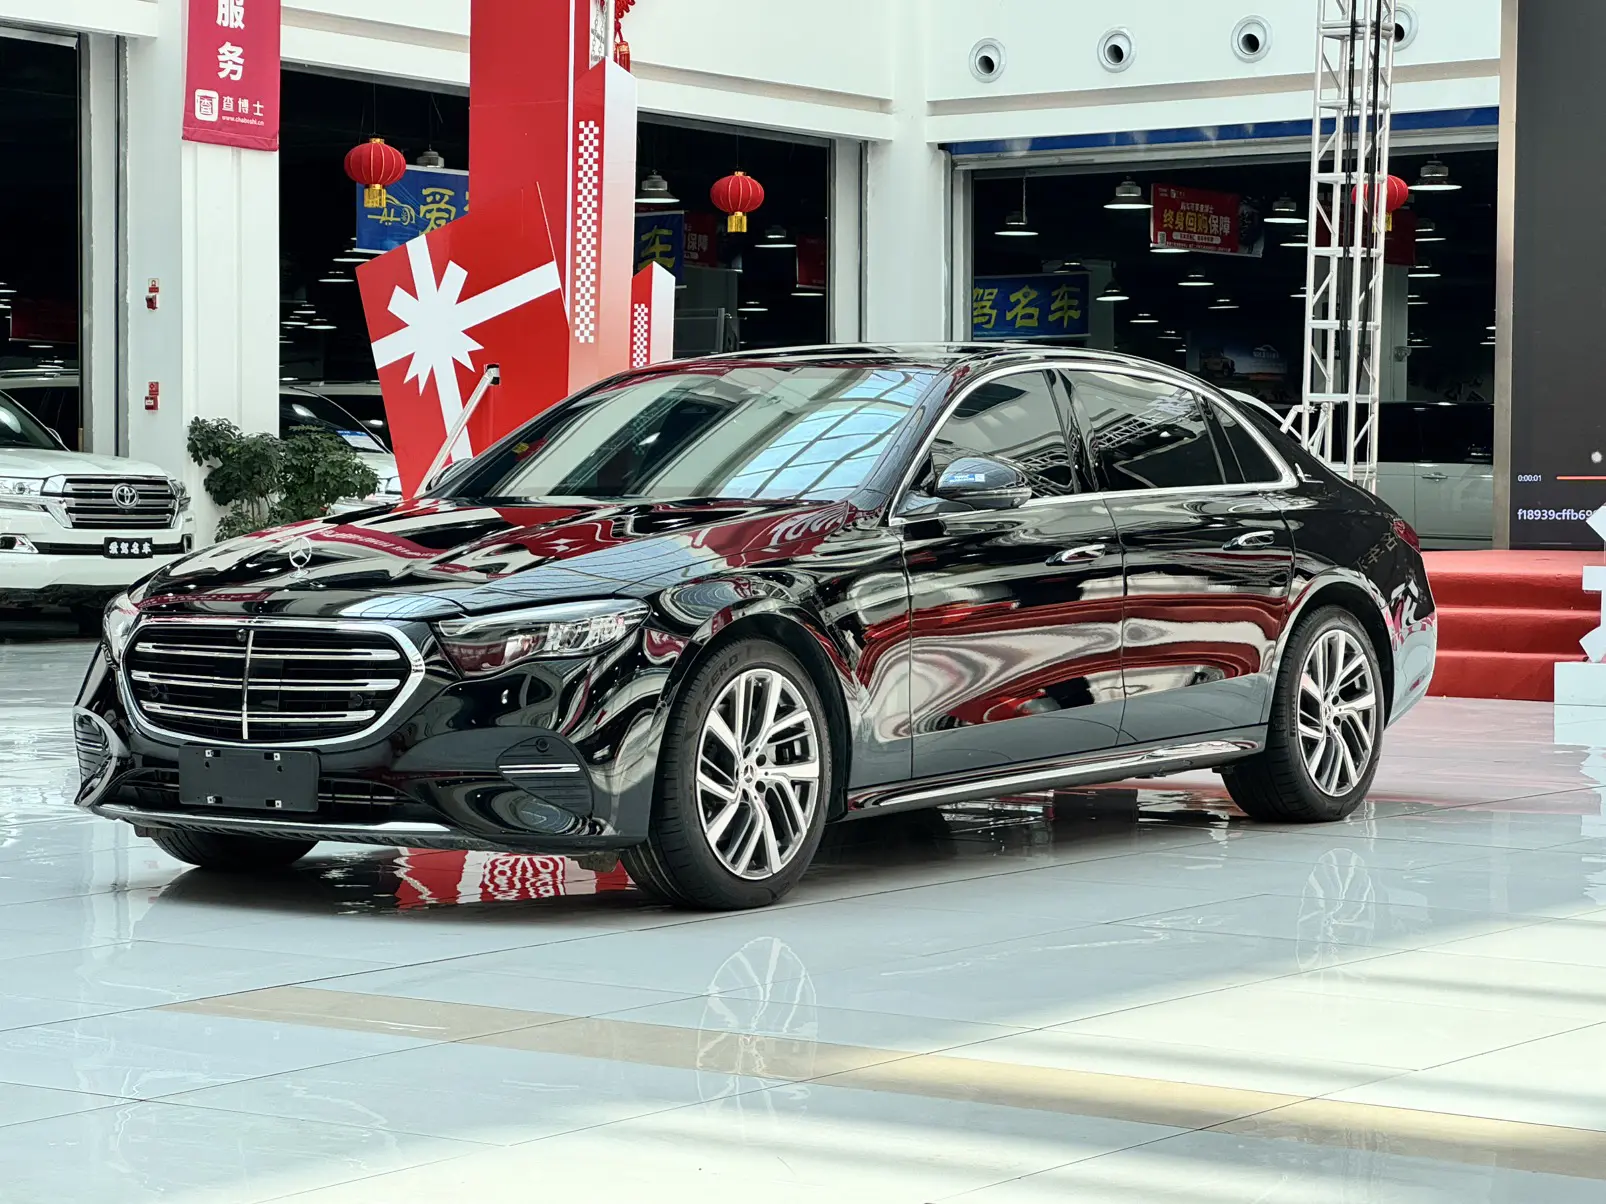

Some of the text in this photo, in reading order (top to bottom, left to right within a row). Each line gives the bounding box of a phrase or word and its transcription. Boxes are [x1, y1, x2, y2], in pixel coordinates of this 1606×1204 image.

[222, 96, 264, 117] 查博士
[420, 187, 469, 234] 爱
[1163, 208, 1231, 236] 终身回购保障
[684, 233, 709, 253] 保障
[973, 284, 1081, 329] 驾名车
[1517, 474, 1542, 482] 0:00:01
[1517, 508, 1597, 521] f18939cffb69
